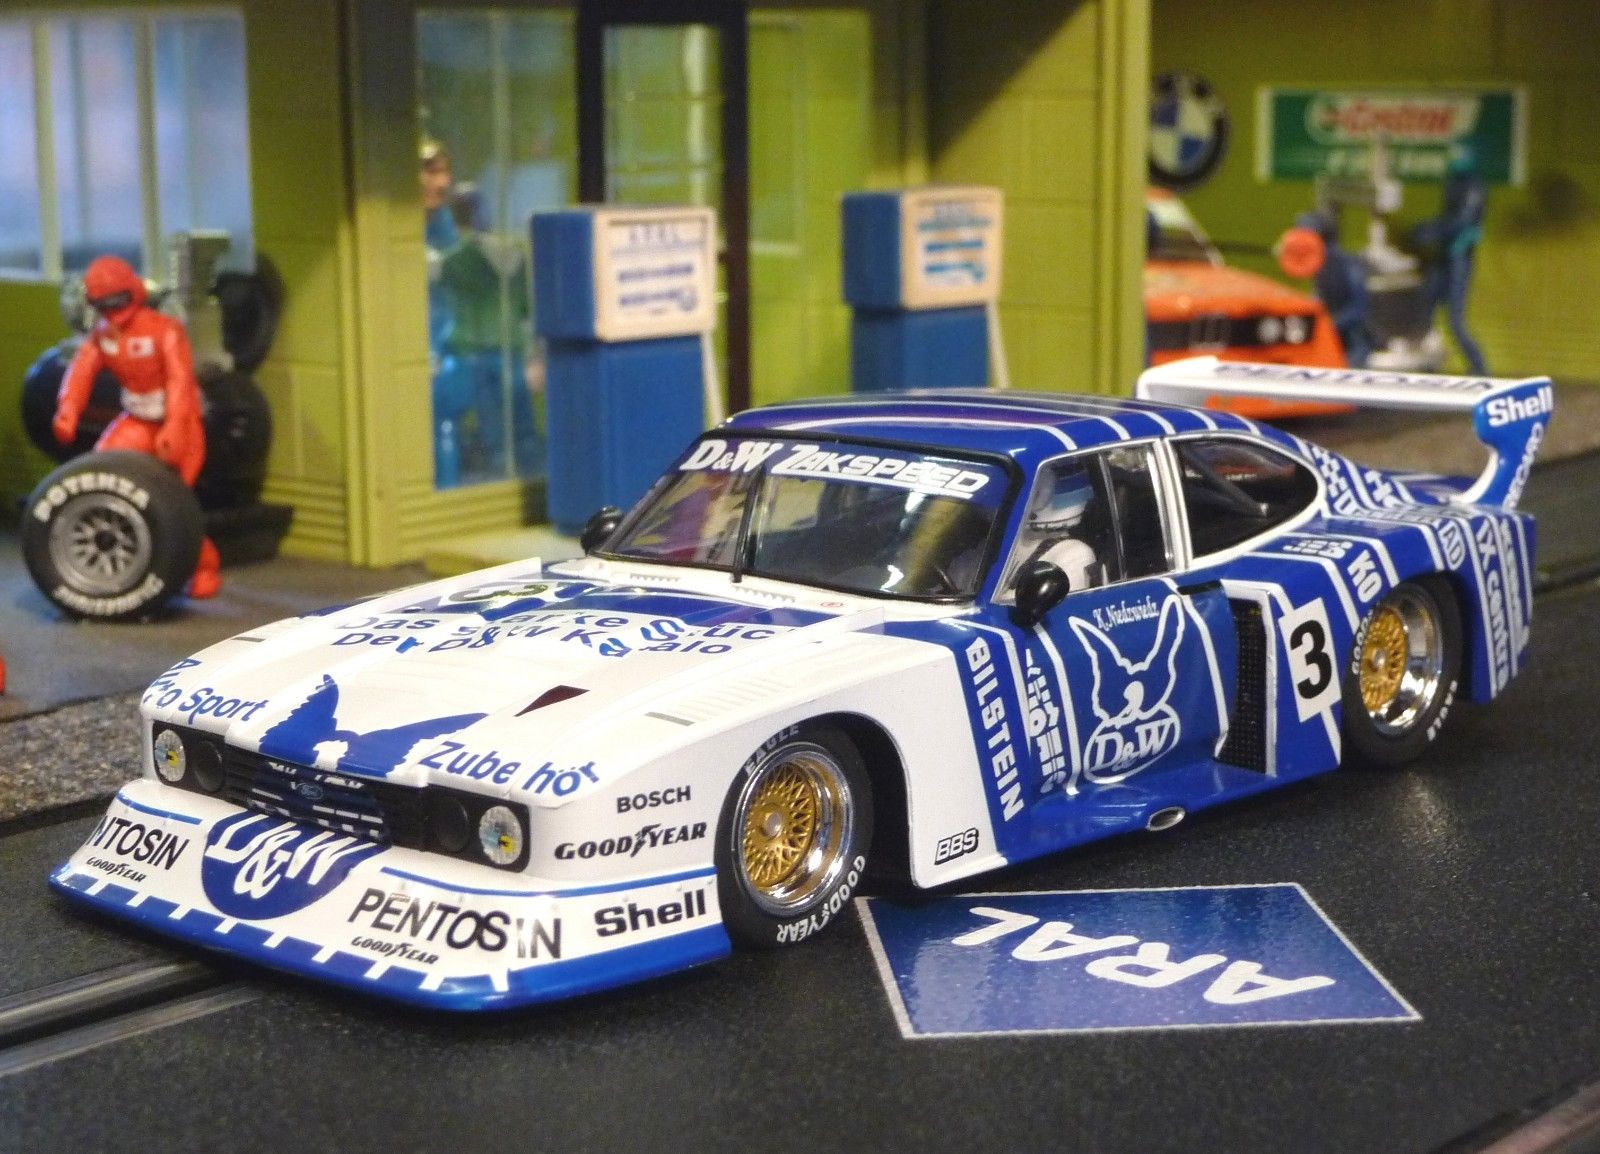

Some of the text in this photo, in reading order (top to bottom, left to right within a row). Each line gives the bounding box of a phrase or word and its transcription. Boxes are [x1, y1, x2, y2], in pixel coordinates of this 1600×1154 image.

[1486, 385, 1554, 427] Shell
[680, 439, 989, 499] D&W ZAKSPEED
[1290, 619, 1332, 700] 3
[177, 687, 270, 725] Sport
[965, 636, 1025, 822] BILSTEIN
[743, 724, 801, 778] EAGLE
[1088, 716, 1174, 772] D&W
[616, 785, 692, 814] BOSCH
[204, 813, 378, 900] D&W
[553, 821, 708, 860] GOODYEAR
[934, 827, 979, 865] BBS
[86, 856, 147, 883] GOODYEAR
[347, 887, 563, 960] PENTOSIN
[593, 888, 707, 938] Shell
[776, 855, 867, 944] GOODYEAR
[350, 935, 439, 965] GOODYEAR
[950, 906, 1337, 1005] ARAL
